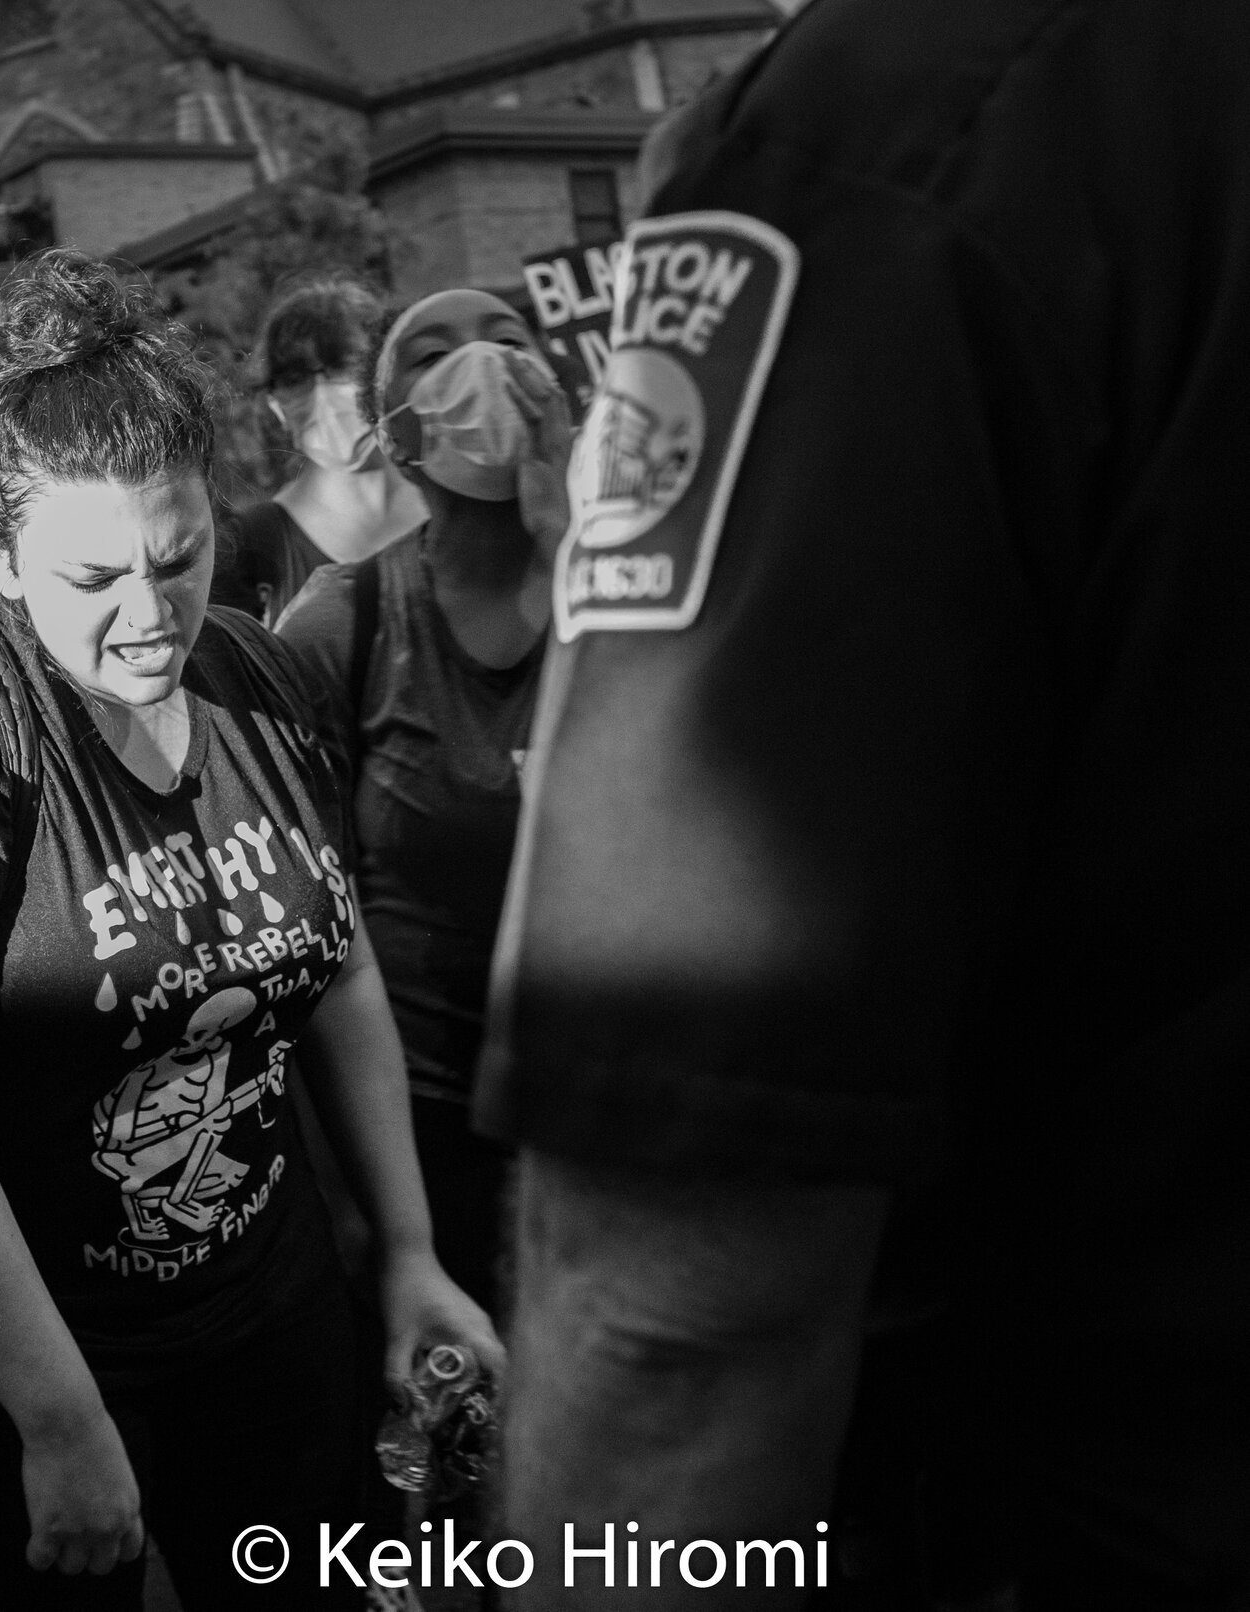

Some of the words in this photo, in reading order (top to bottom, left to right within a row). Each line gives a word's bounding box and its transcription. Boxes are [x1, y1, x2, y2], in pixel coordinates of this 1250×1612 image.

[290, 827, 347, 898] IS
[131, 942, 217, 1022] MORE
[259, 967, 330, 1001] THAN
[253, 1010, 277, 1038] A
[83, 1242, 211, 1282] MIDDLE
